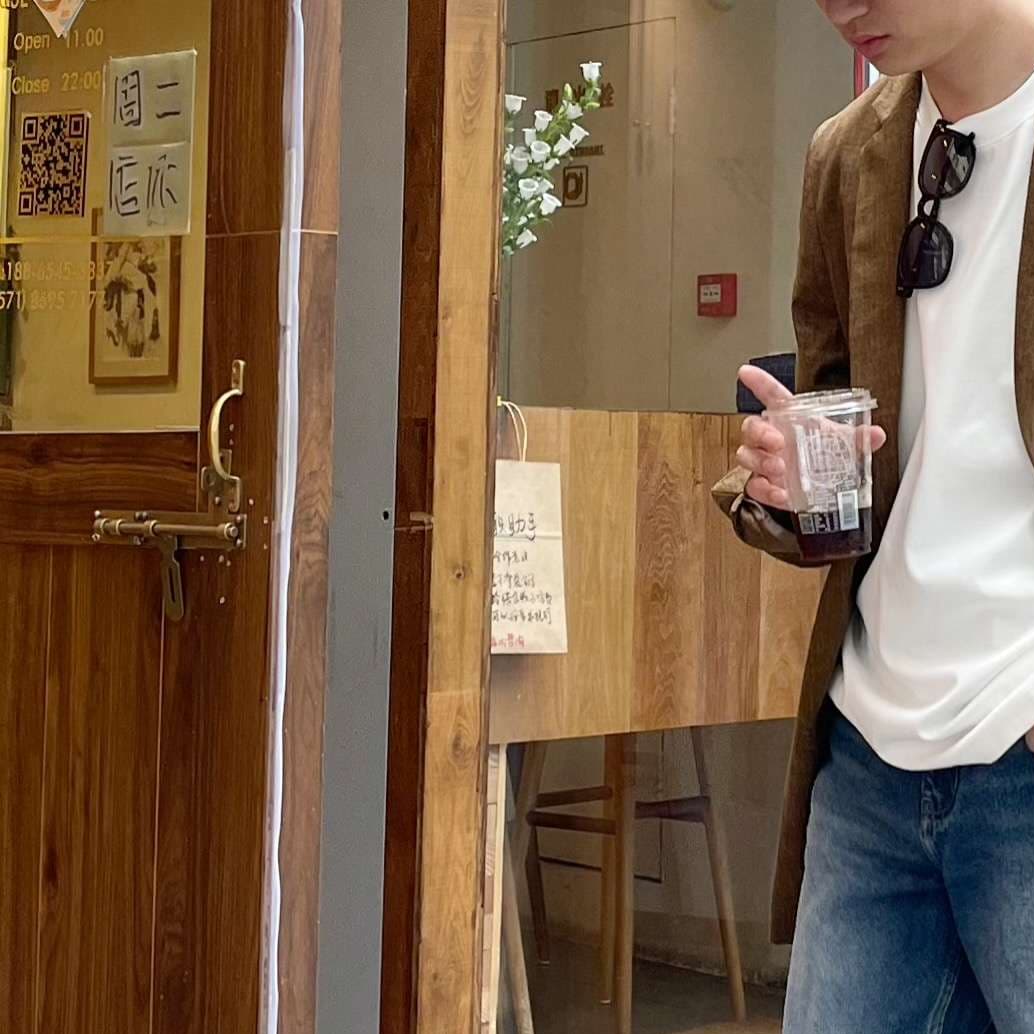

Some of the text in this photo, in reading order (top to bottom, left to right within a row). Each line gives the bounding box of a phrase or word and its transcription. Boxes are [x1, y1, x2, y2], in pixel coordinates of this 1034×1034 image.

[14, 33, 50, 54] Open
[12, 76, 49, 95] Close
[113, 70, 181, 127] 周二
